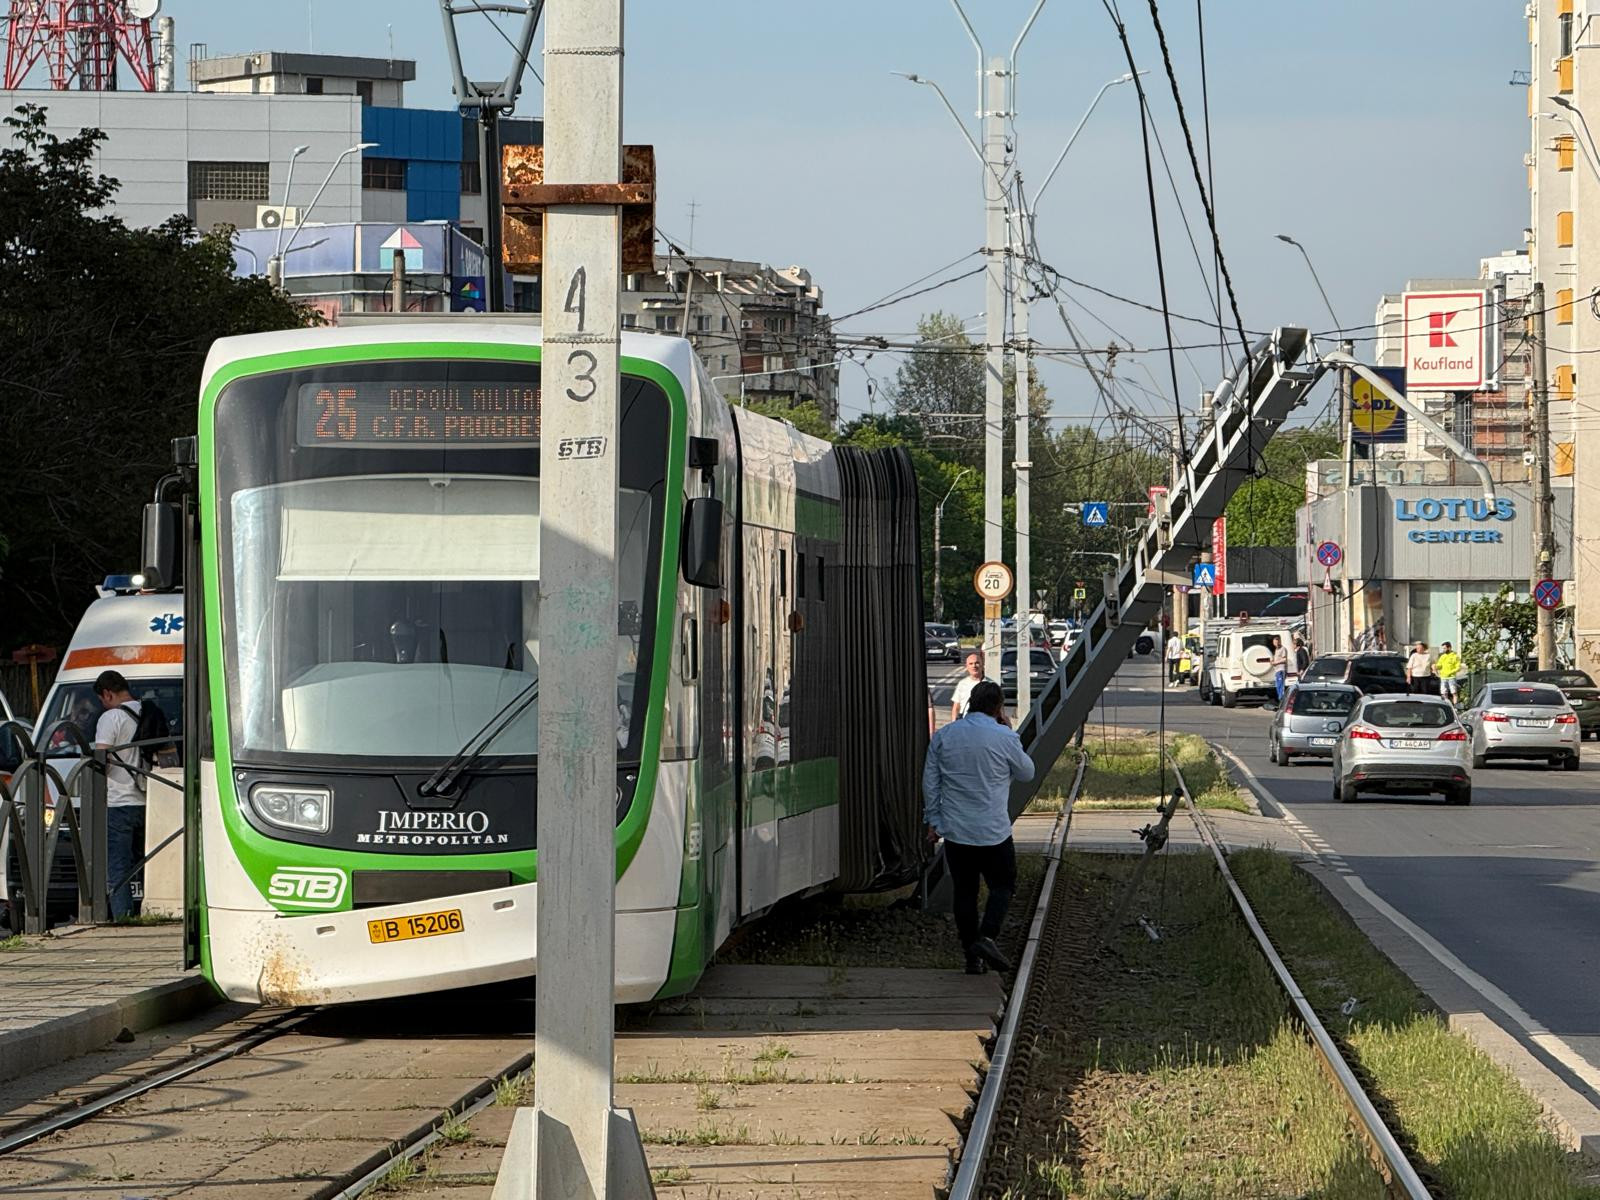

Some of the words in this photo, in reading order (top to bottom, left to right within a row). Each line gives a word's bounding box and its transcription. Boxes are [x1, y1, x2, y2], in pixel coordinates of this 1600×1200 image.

[1413, 356, 1473, 371] Kaufland
[390, 389, 464, 410] DEPOUL
[316, 389, 357, 440] 25
[1395, 498, 1516, 522] LOTUS
[1407, 529, 1503, 544] CENTER
[984, 579, 1000, 590] 20
[376, 810, 489, 833] IMPERIO
[356, 833, 509, 845] METROPOLITAN
[268, 871, 340, 902] STB
[385, 920, 400, 938] B
[407, 911, 461, 936] 15206
